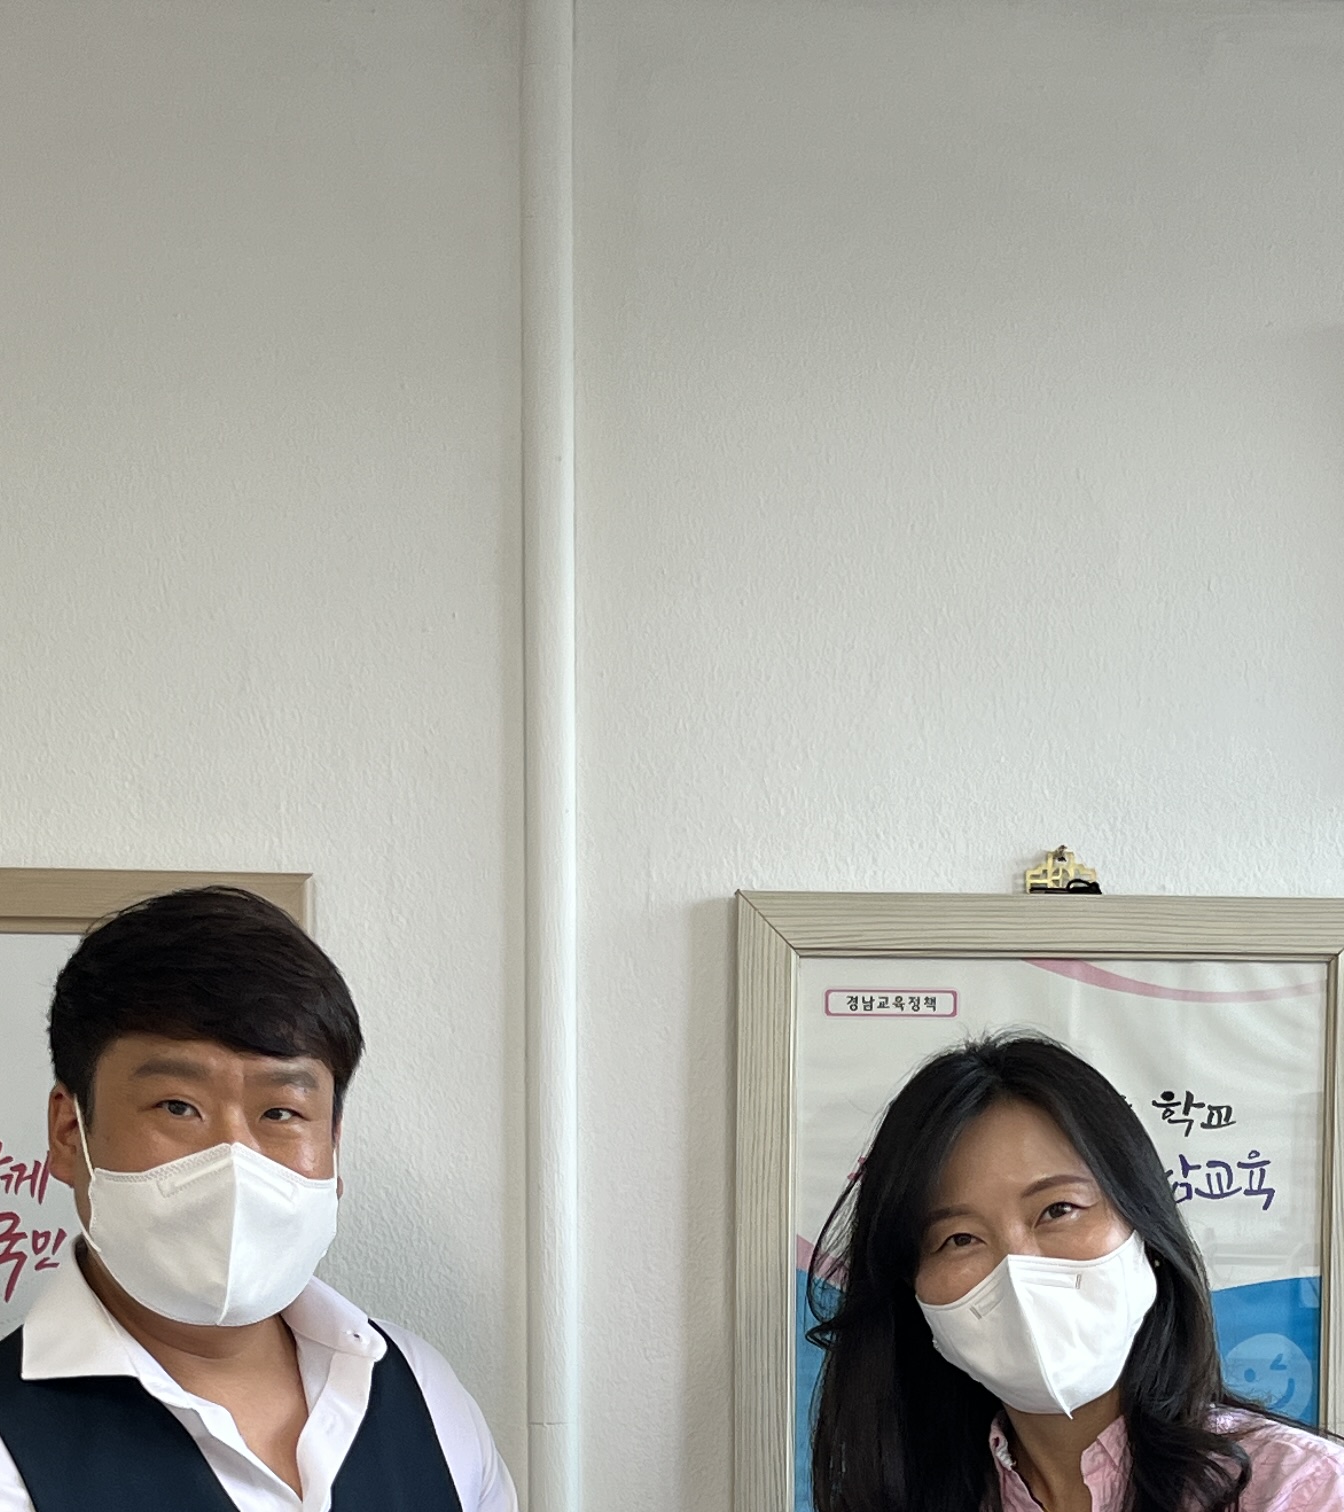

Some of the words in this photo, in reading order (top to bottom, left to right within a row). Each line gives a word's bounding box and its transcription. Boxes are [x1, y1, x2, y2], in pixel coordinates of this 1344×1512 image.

[846, 995, 937, 1012] 경남교육정책
[1151, 1090, 1236, 1137] 학교
[1164, 1150, 1276, 1211] 남교육
